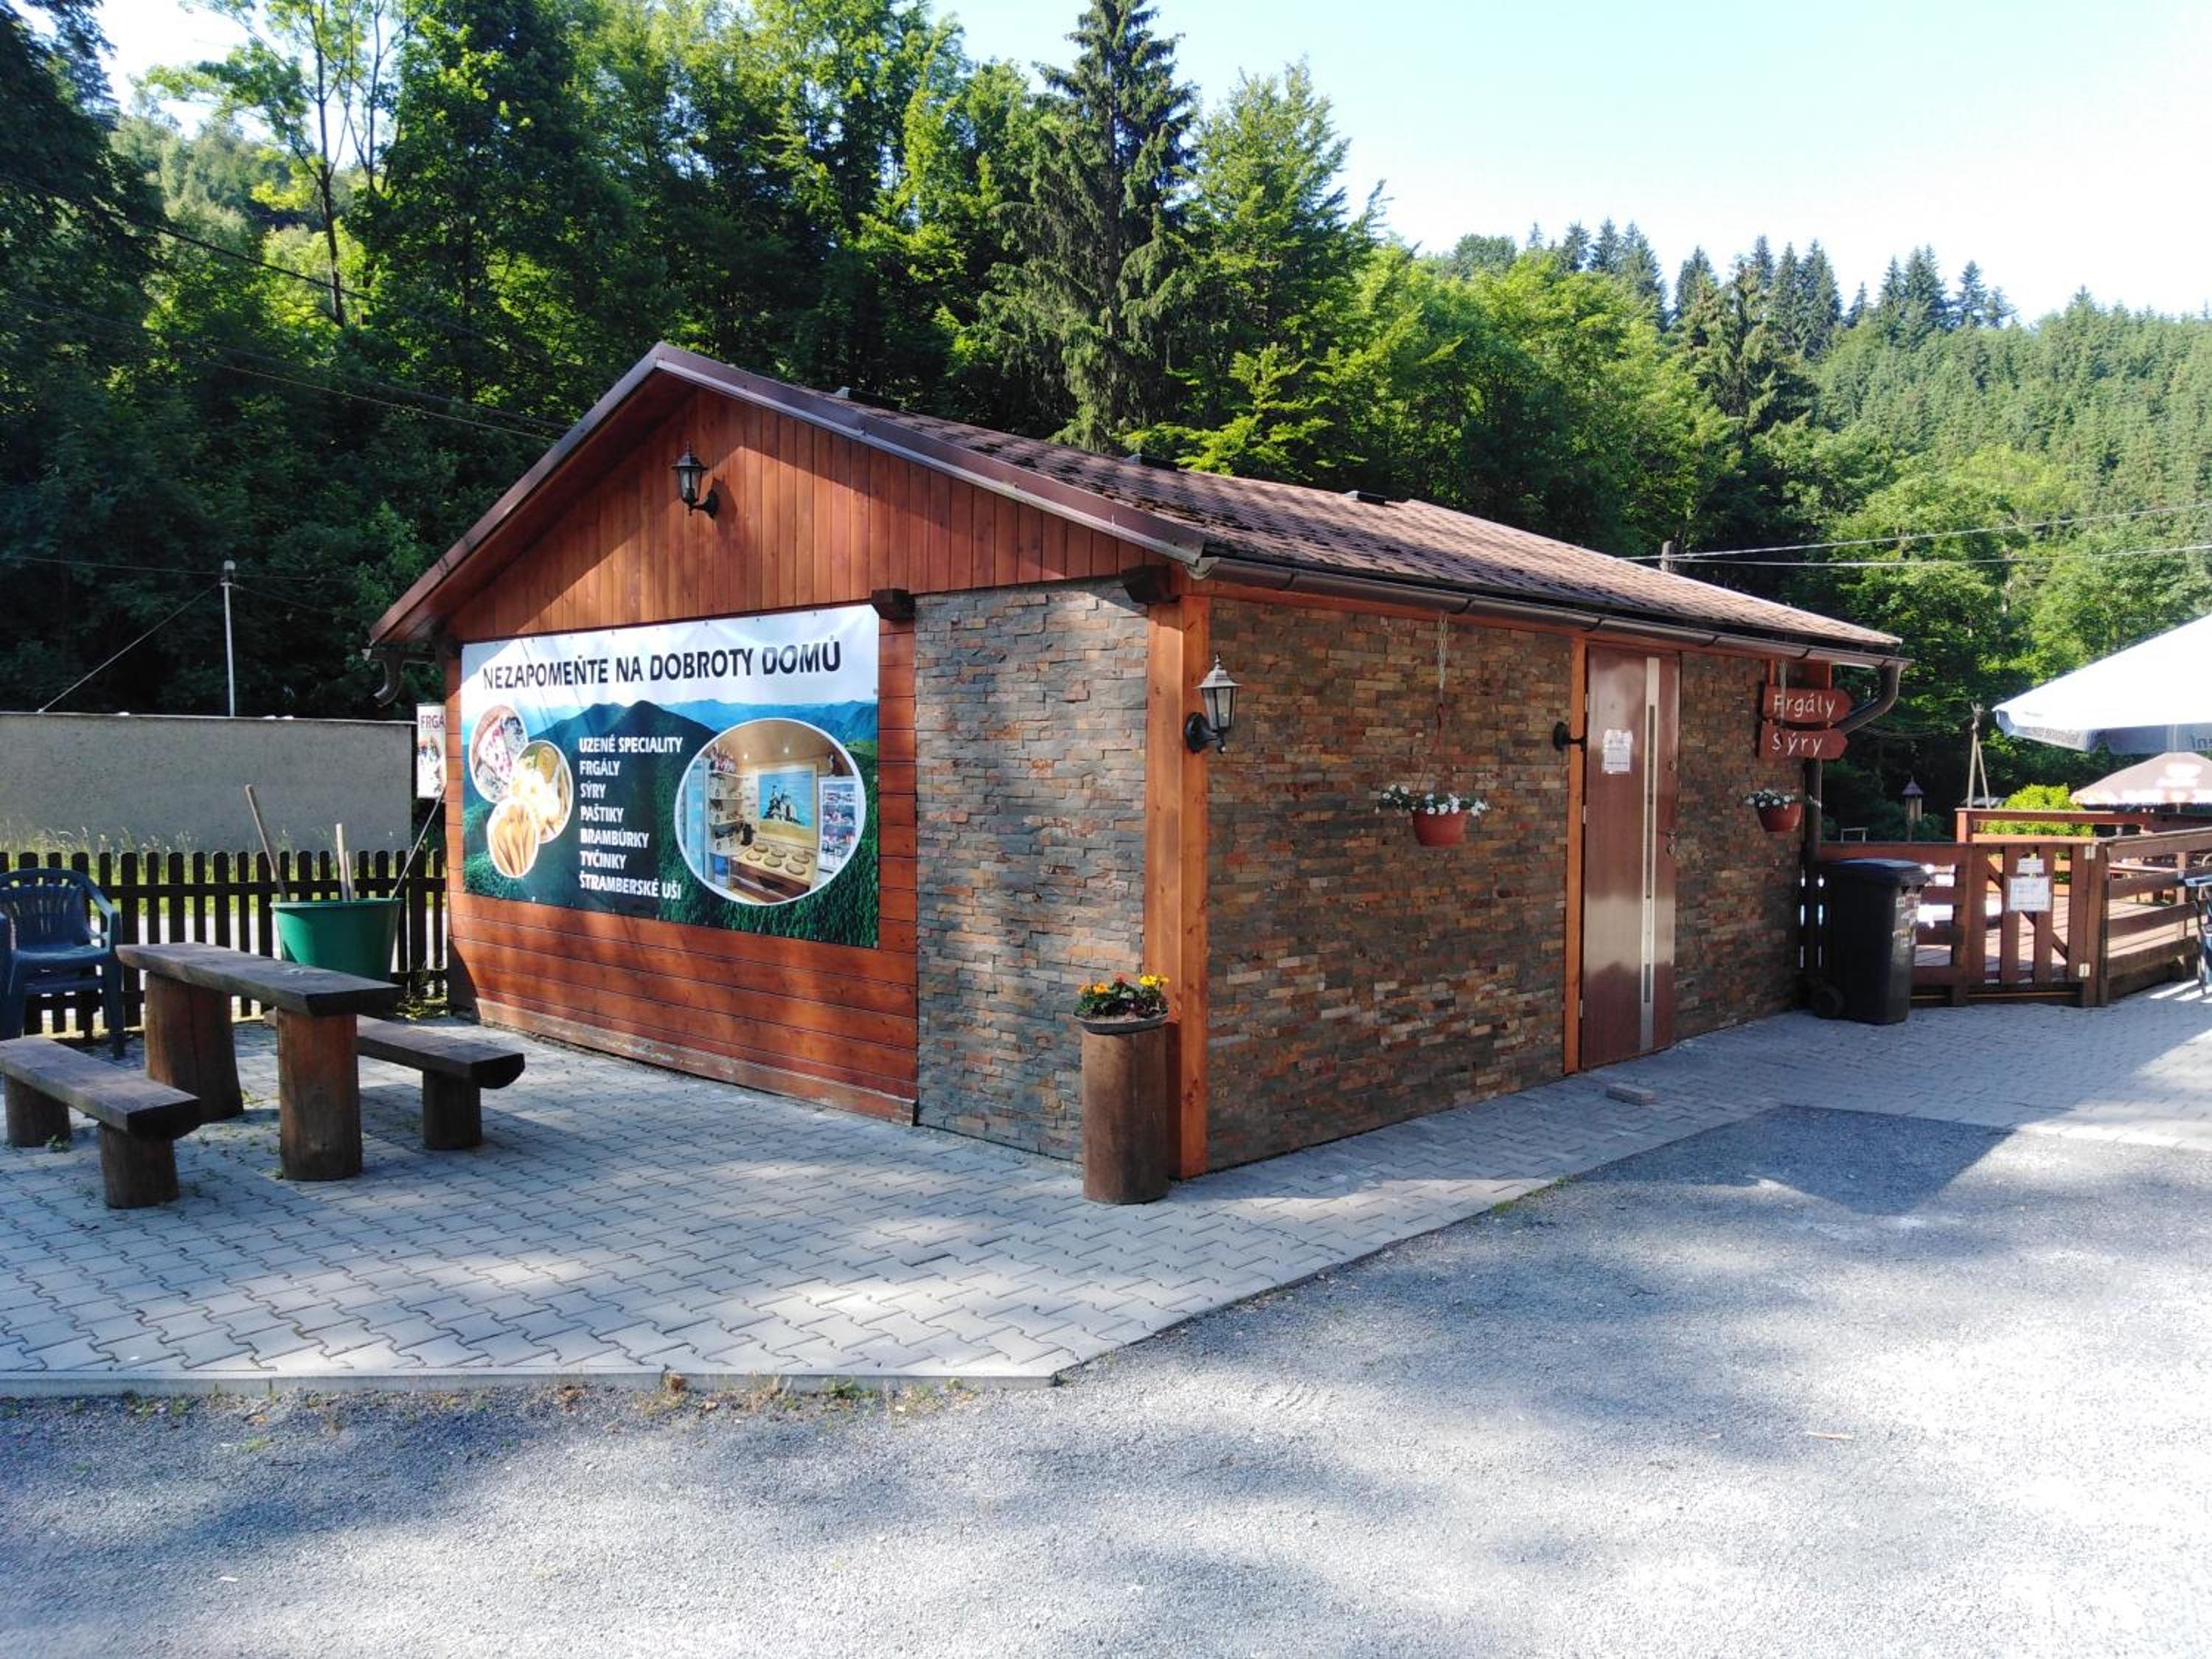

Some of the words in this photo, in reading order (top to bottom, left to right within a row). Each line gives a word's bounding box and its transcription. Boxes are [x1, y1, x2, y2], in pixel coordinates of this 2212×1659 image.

[484, 655, 608, 689] NEZAPOMEŇTE
[616, 655, 643, 683] NA
[650, 649, 754, 681] DOBROTY
[762, 635, 841, 675] DOMŮ
[1773, 693, 1835, 718] Frgály
[579, 734, 616, 753] UZENÉ
[618, 737, 684, 753] SPECIALITY
[1772, 732, 1823, 757] Sýry
[579, 757, 621, 776] FRGÁLY
[580, 780, 607, 799] SÝRY
[580, 803, 625, 824] PAŠTIKY
[580, 827, 650, 849] BRAMBÚRKY
[579, 849, 627, 870] TYČINKY
[579, 870, 659, 897] ŠTRAMBERSKÉ
[661, 879, 681, 900] UŠI
